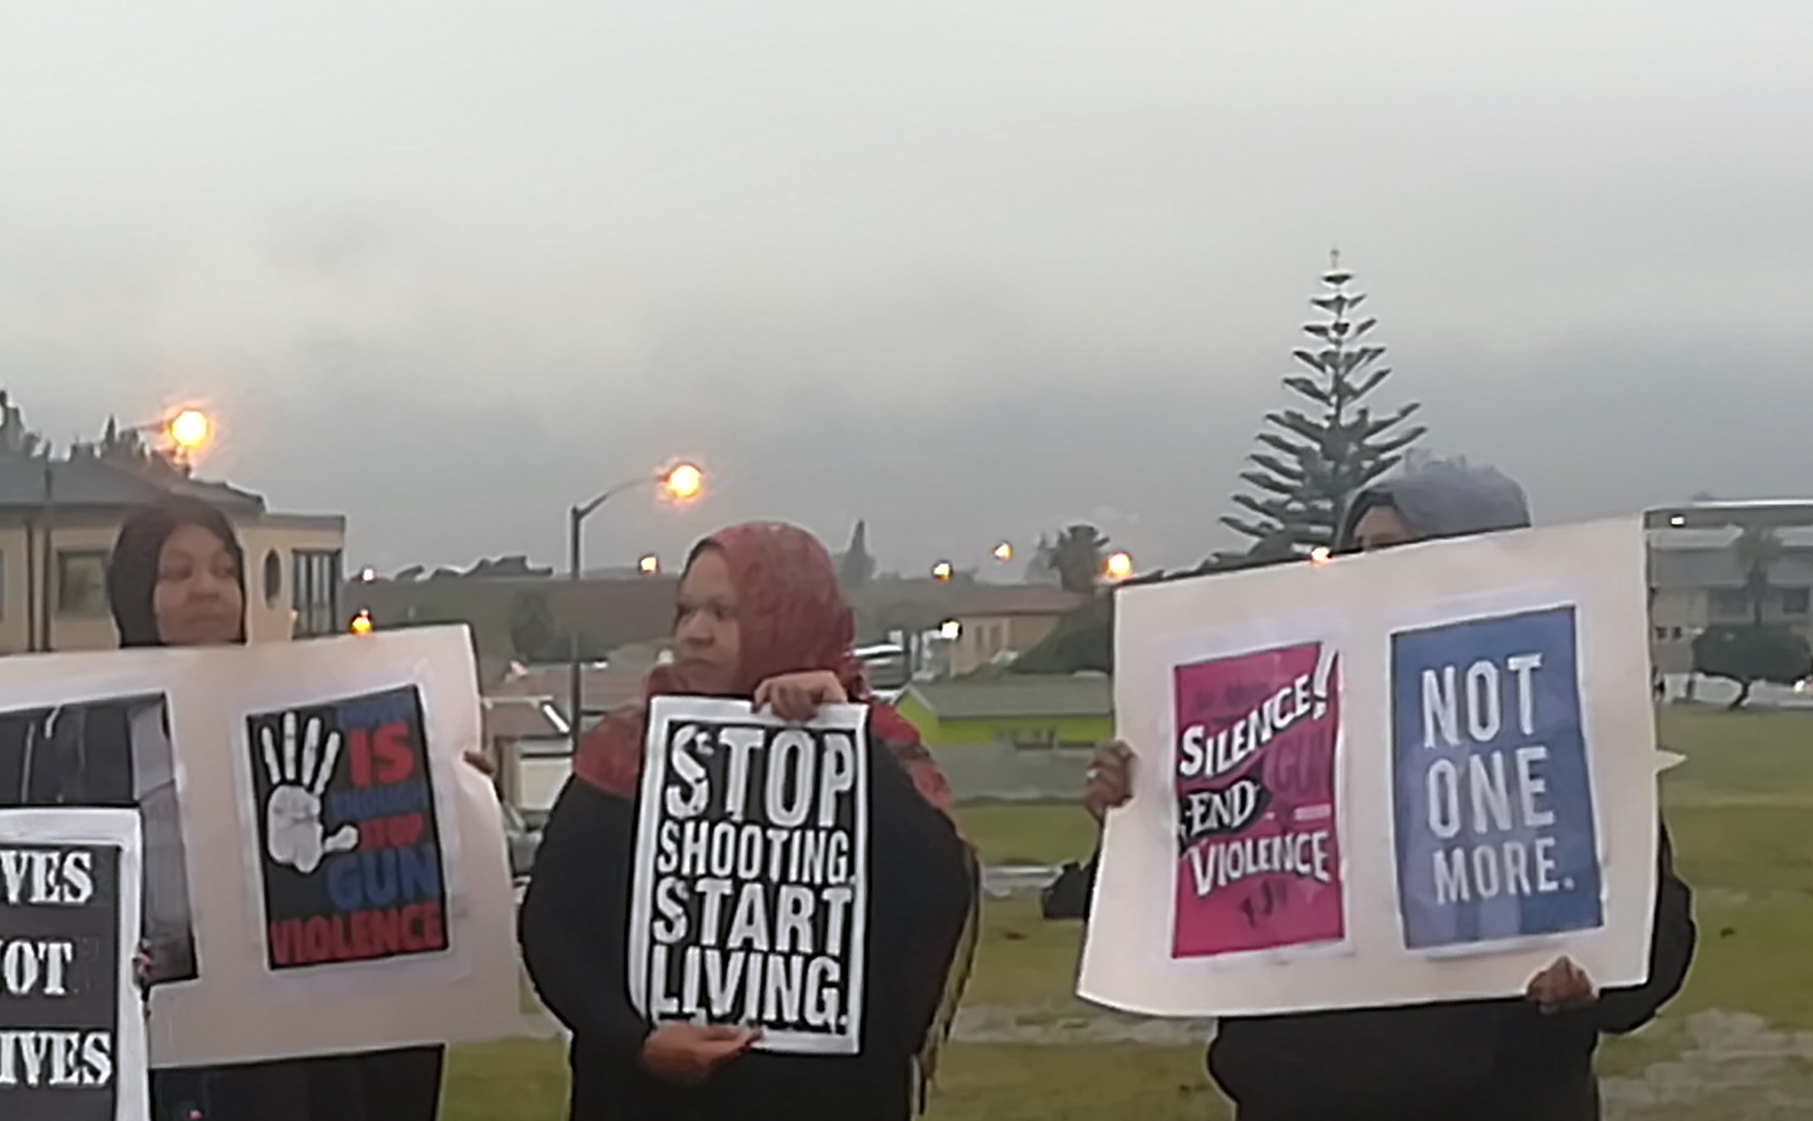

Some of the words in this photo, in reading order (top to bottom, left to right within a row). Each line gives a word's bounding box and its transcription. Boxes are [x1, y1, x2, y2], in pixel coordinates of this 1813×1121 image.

[1179, 648, 1339, 779] SILENCE!
[1421, 653, 1544, 750] NOT
[348, 721, 415, 787] IS
[665, 724, 855, 828] STOP
[1187, 776, 1259, 838] END
[1427, 746, 1555, 838] ONE
[326, 845, 439, 910] GUN
[1187, 830, 1333, 898] VIOLENCE
[1433, 837, 1574, 905] MORE.
[269, 903, 441, 965] VIOLENCE
[653, 876, 852, 956] START
